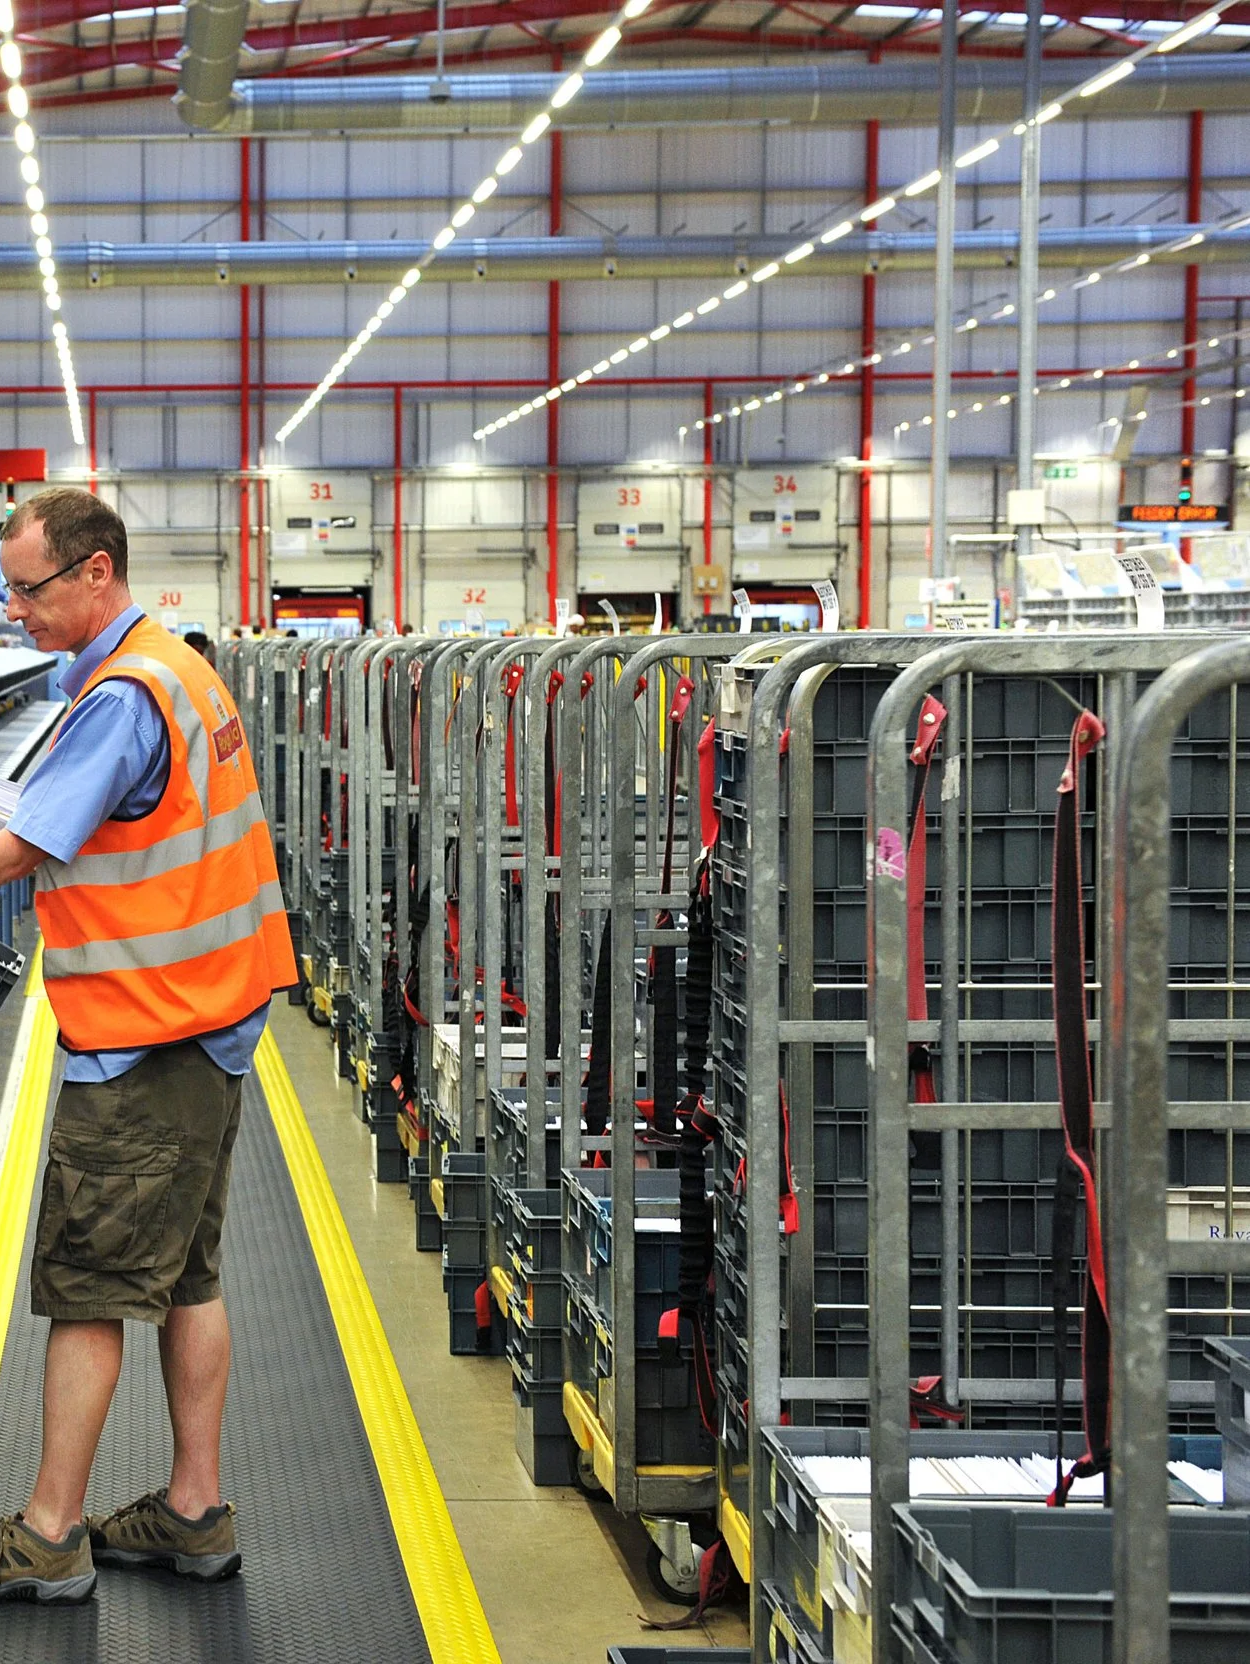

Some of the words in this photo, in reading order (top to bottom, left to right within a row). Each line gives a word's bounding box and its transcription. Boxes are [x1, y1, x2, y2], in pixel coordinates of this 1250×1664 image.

[309, 483, 334, 500] 31
[773, 475, 798, 494] 34
[617, 488, 642, 506] 33
[462, 587, 487, 604] 32
